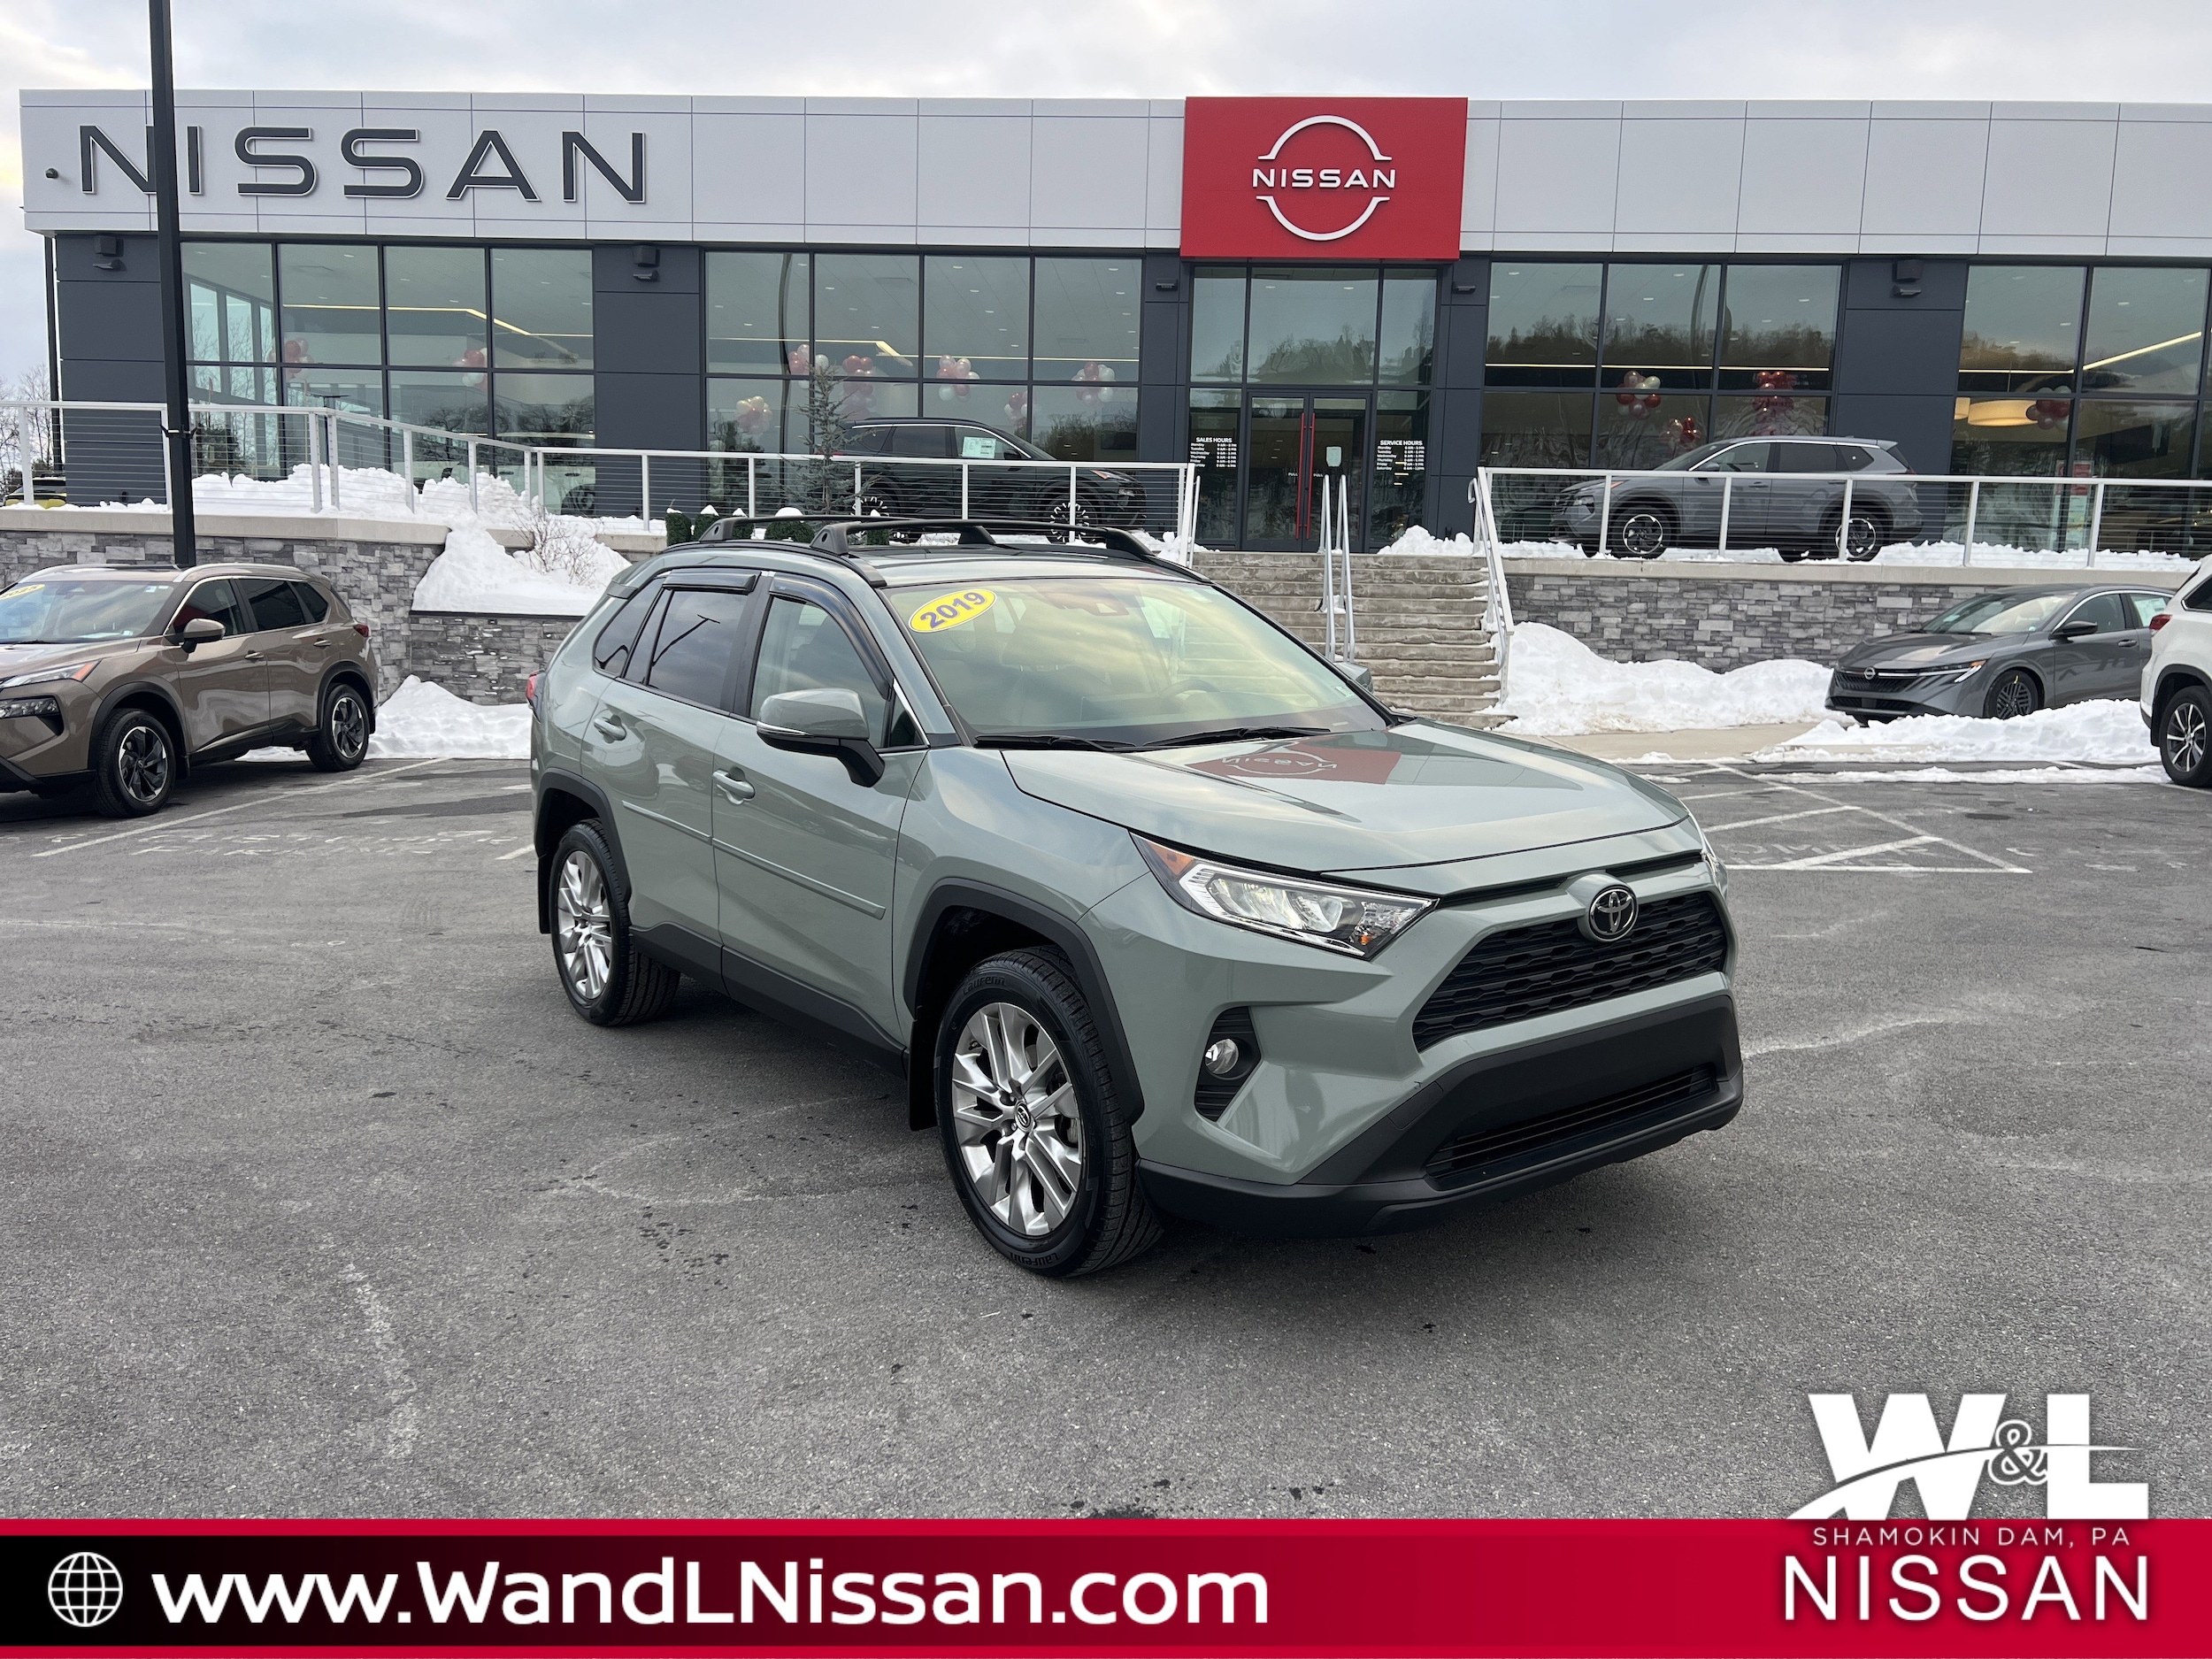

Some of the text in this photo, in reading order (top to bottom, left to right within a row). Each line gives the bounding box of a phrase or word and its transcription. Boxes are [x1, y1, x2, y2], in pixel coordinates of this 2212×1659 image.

[79, 124, 647, 204] NISSAN
[1252, 168, 1396, 188] NISSAN
[920, 592, 986, 629] 2019
